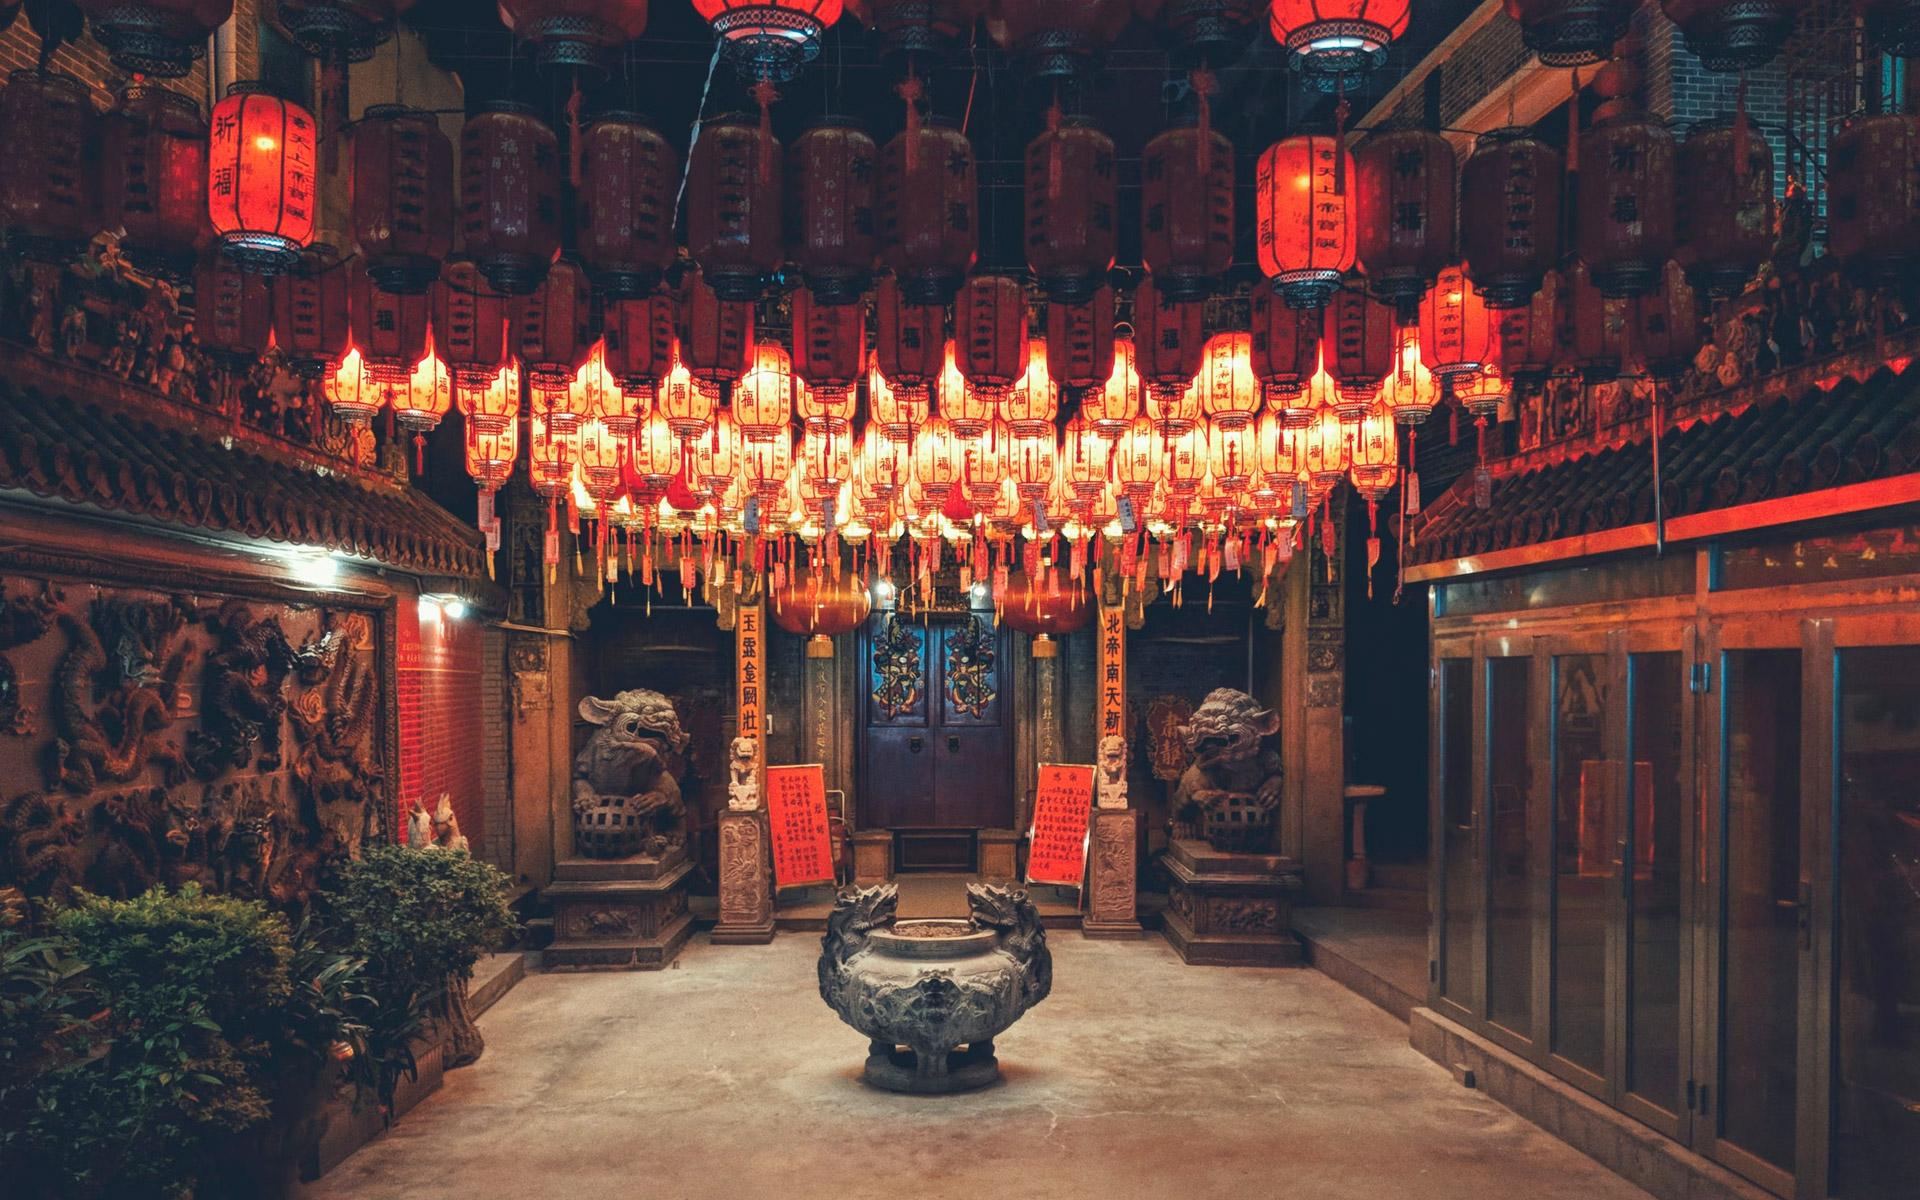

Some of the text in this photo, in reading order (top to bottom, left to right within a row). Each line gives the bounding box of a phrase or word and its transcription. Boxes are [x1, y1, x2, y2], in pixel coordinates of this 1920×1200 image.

[213, 114, 236, 196] 祈福
[373, 308, 396, 332] 福
[741, 390, 756, 408] 福
[1012, 388, 1028, 406] 福
[1308, 419, 1321, 459] 祈福
[1177, 450, 1191, 465] 福
